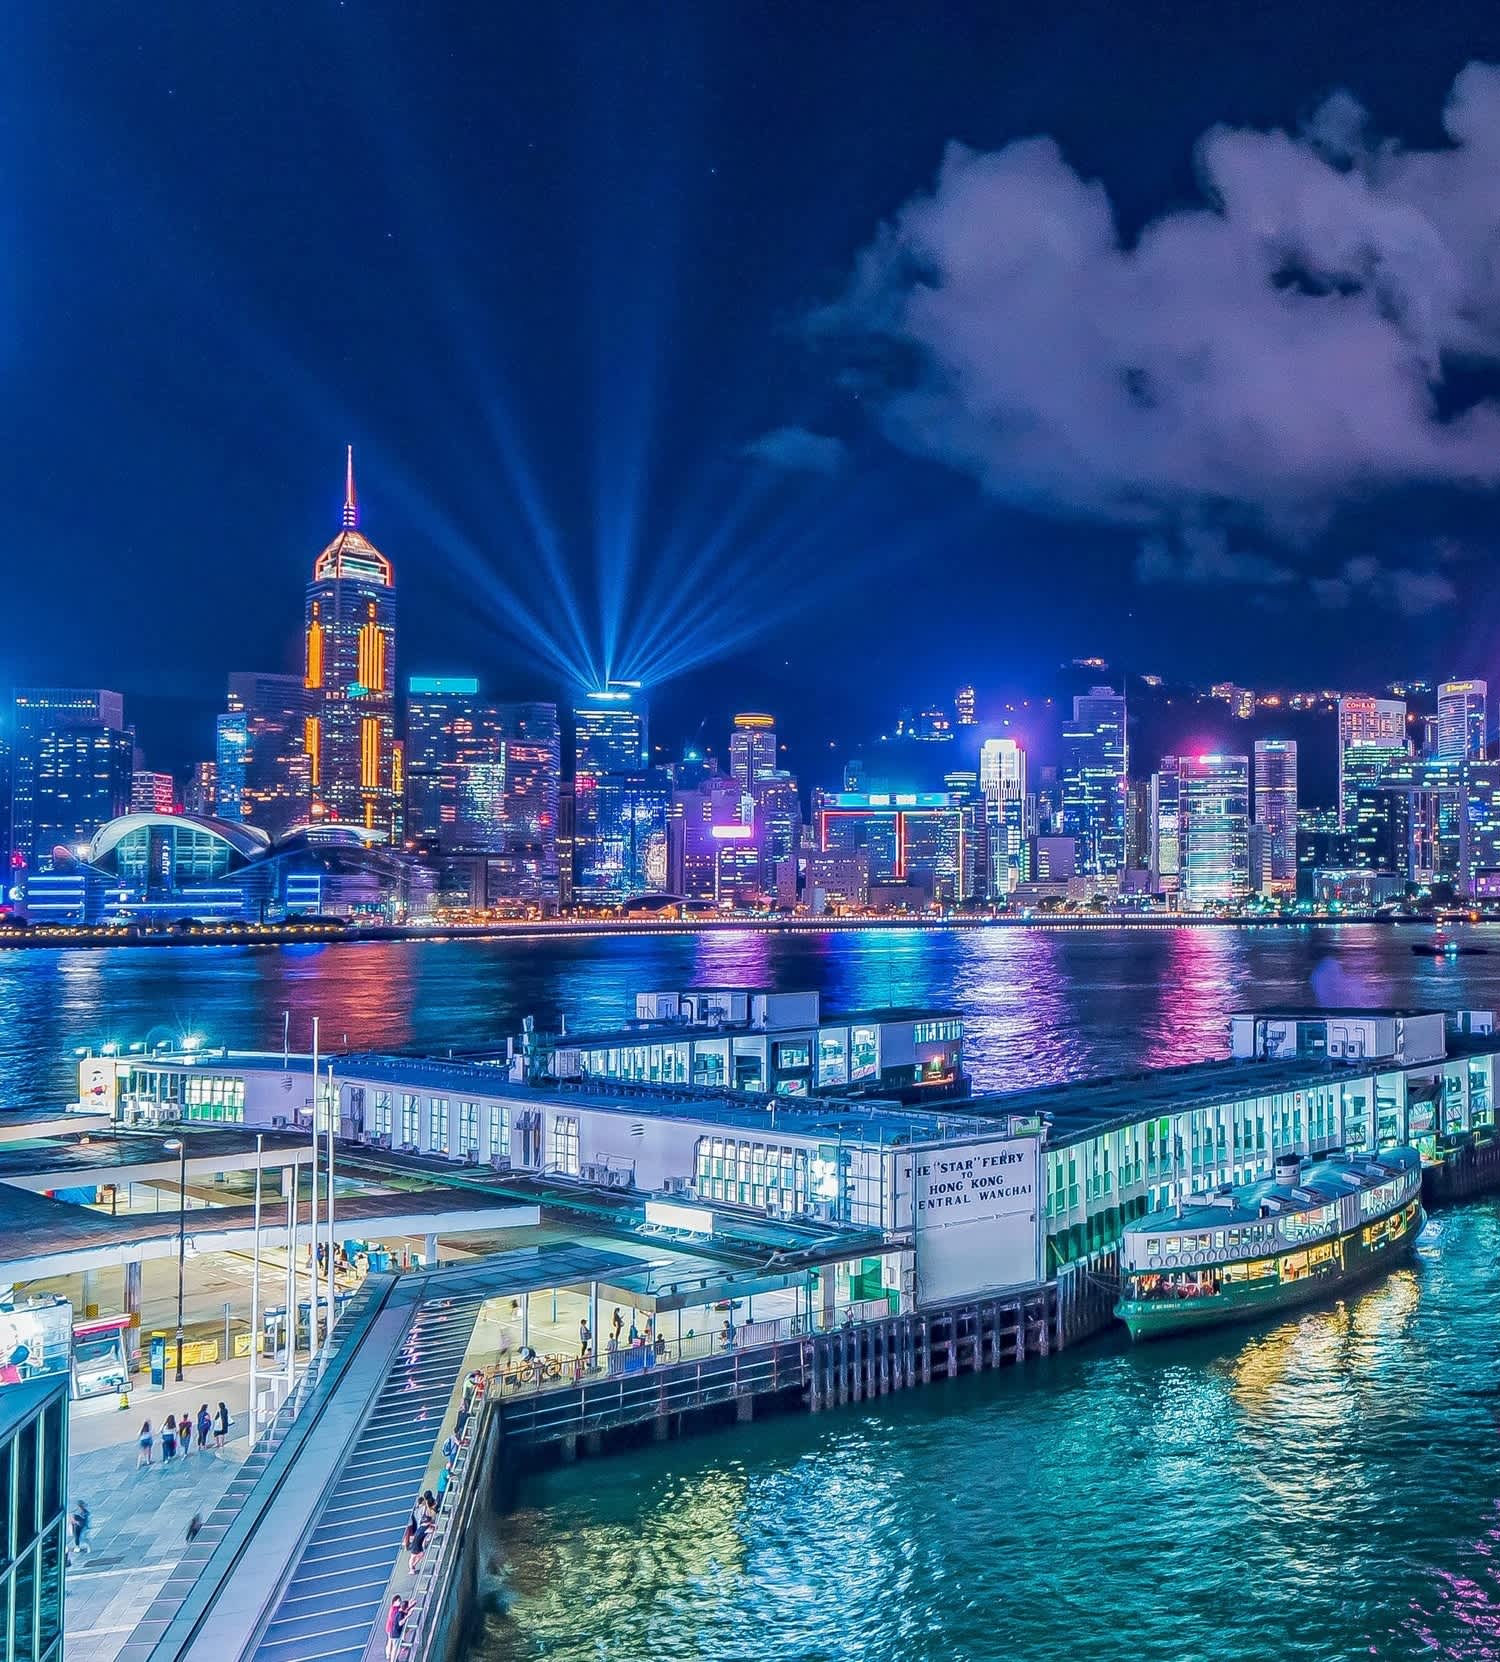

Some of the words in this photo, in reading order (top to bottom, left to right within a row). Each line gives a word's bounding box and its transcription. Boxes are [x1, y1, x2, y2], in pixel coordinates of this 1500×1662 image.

[982, 1152, 1025, 1168] FERRY
[961, 1171, 974, 1179] TO
[929, 1181, 964, 1195] HONG
[971, 1175, 1004, 1189] KONG
[979, 1184, 1032, 1200] WANCHAI
